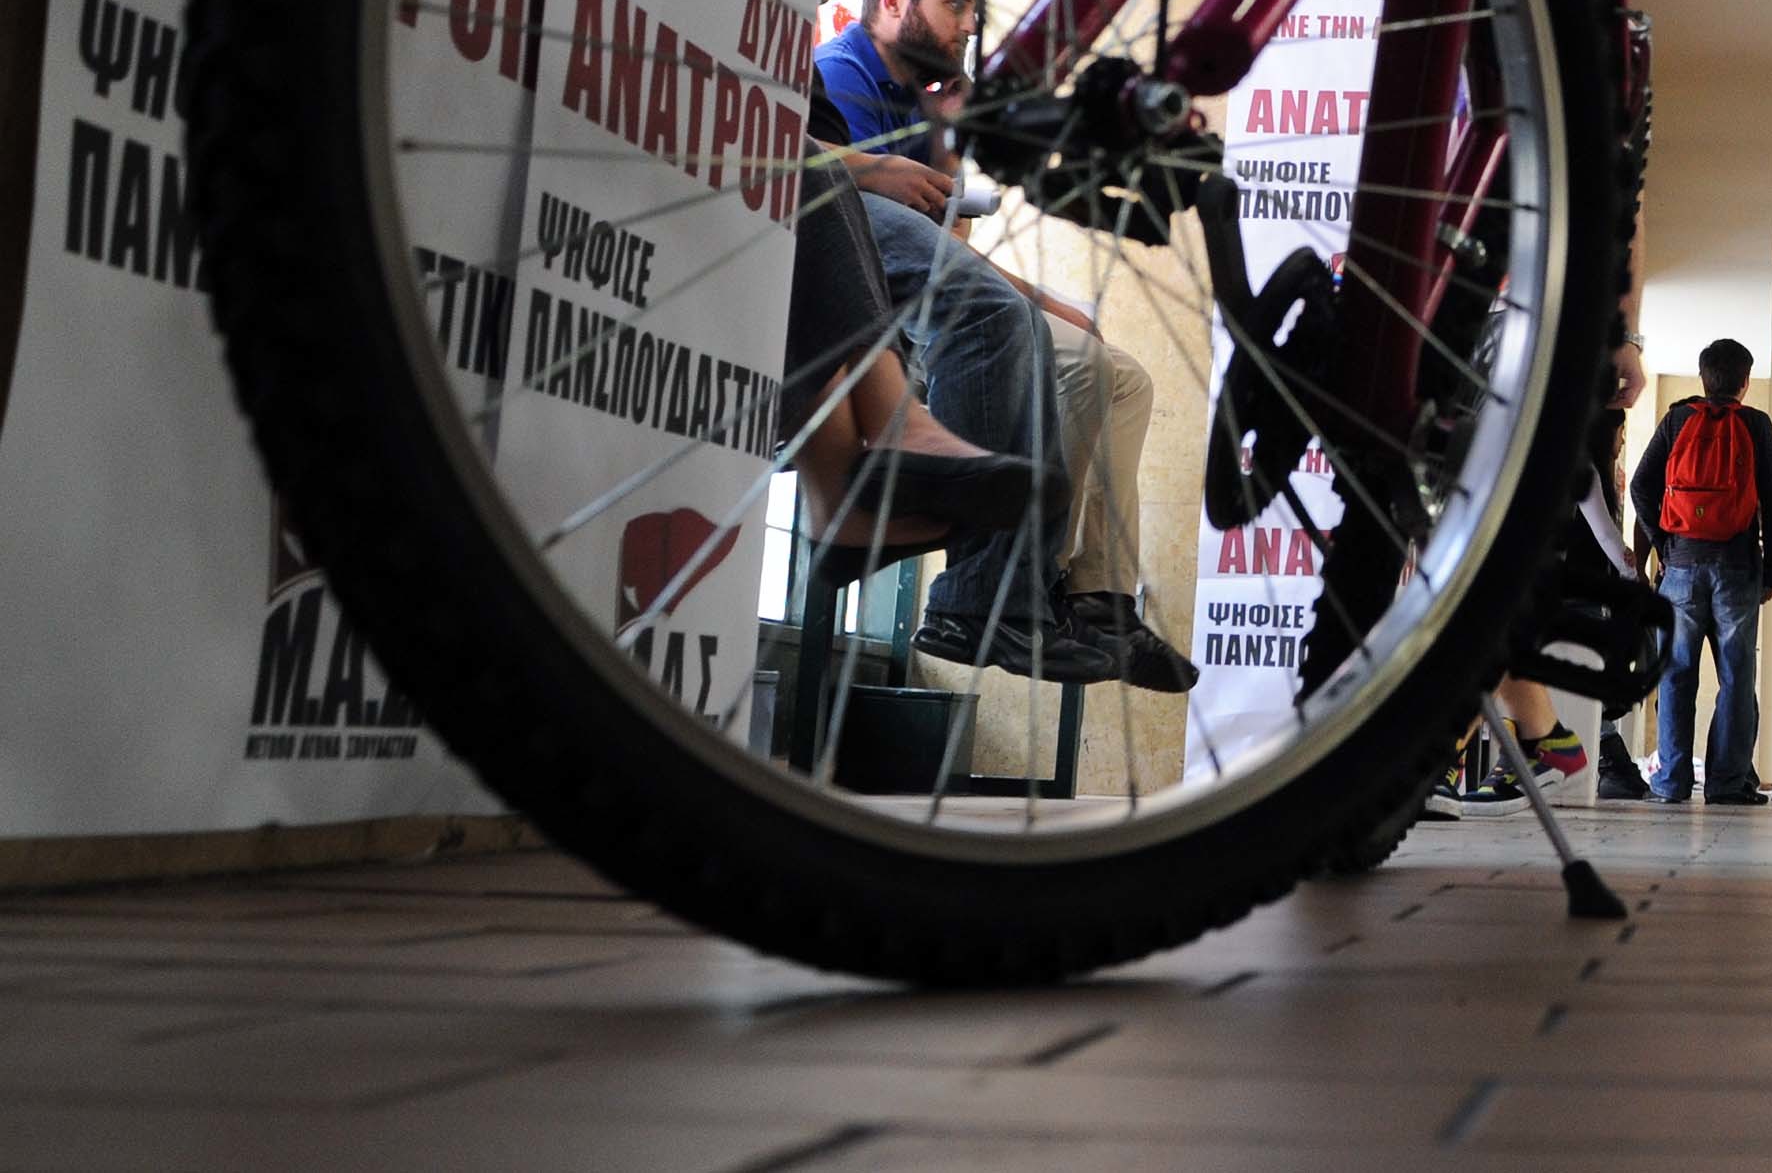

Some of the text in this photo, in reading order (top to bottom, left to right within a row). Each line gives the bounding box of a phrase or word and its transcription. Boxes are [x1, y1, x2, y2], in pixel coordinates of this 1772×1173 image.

[1317, 15, 1365, 40] ΤΗΝ
[1245, 89, 1369, 135] ΑΝΑΤ
[1236, 159, 1332, 184] ΨΗΦΙΣΕ
[535, 191, 656, 309] ΨΗΦΙΣΕ
[1208, 602, 1305, 629] ΨΗΦΙΣΕ
